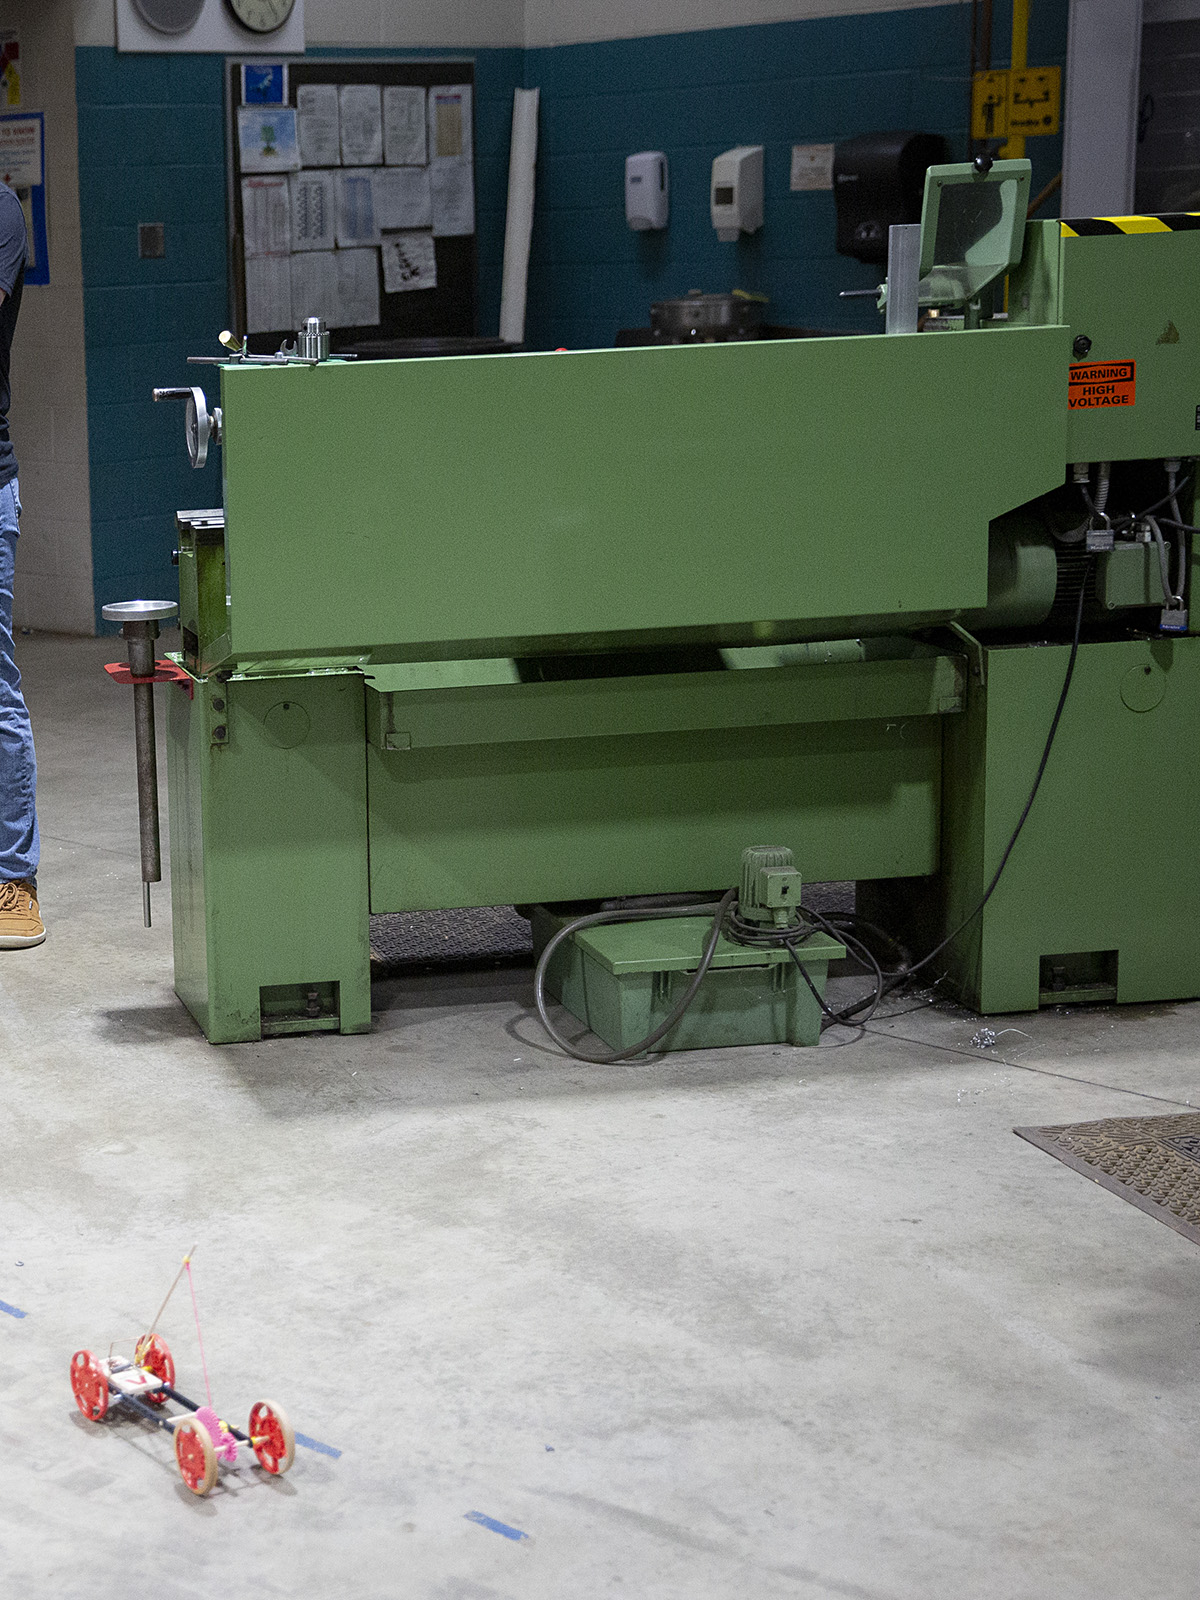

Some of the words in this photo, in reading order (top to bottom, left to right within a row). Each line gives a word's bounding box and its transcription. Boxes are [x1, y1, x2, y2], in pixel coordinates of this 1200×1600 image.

[1070, 367, 1128, 381] WARNING
[1083, 385, 1115, 395] HIGH
[1068, 394, 1129, 408] VOLTAGE
